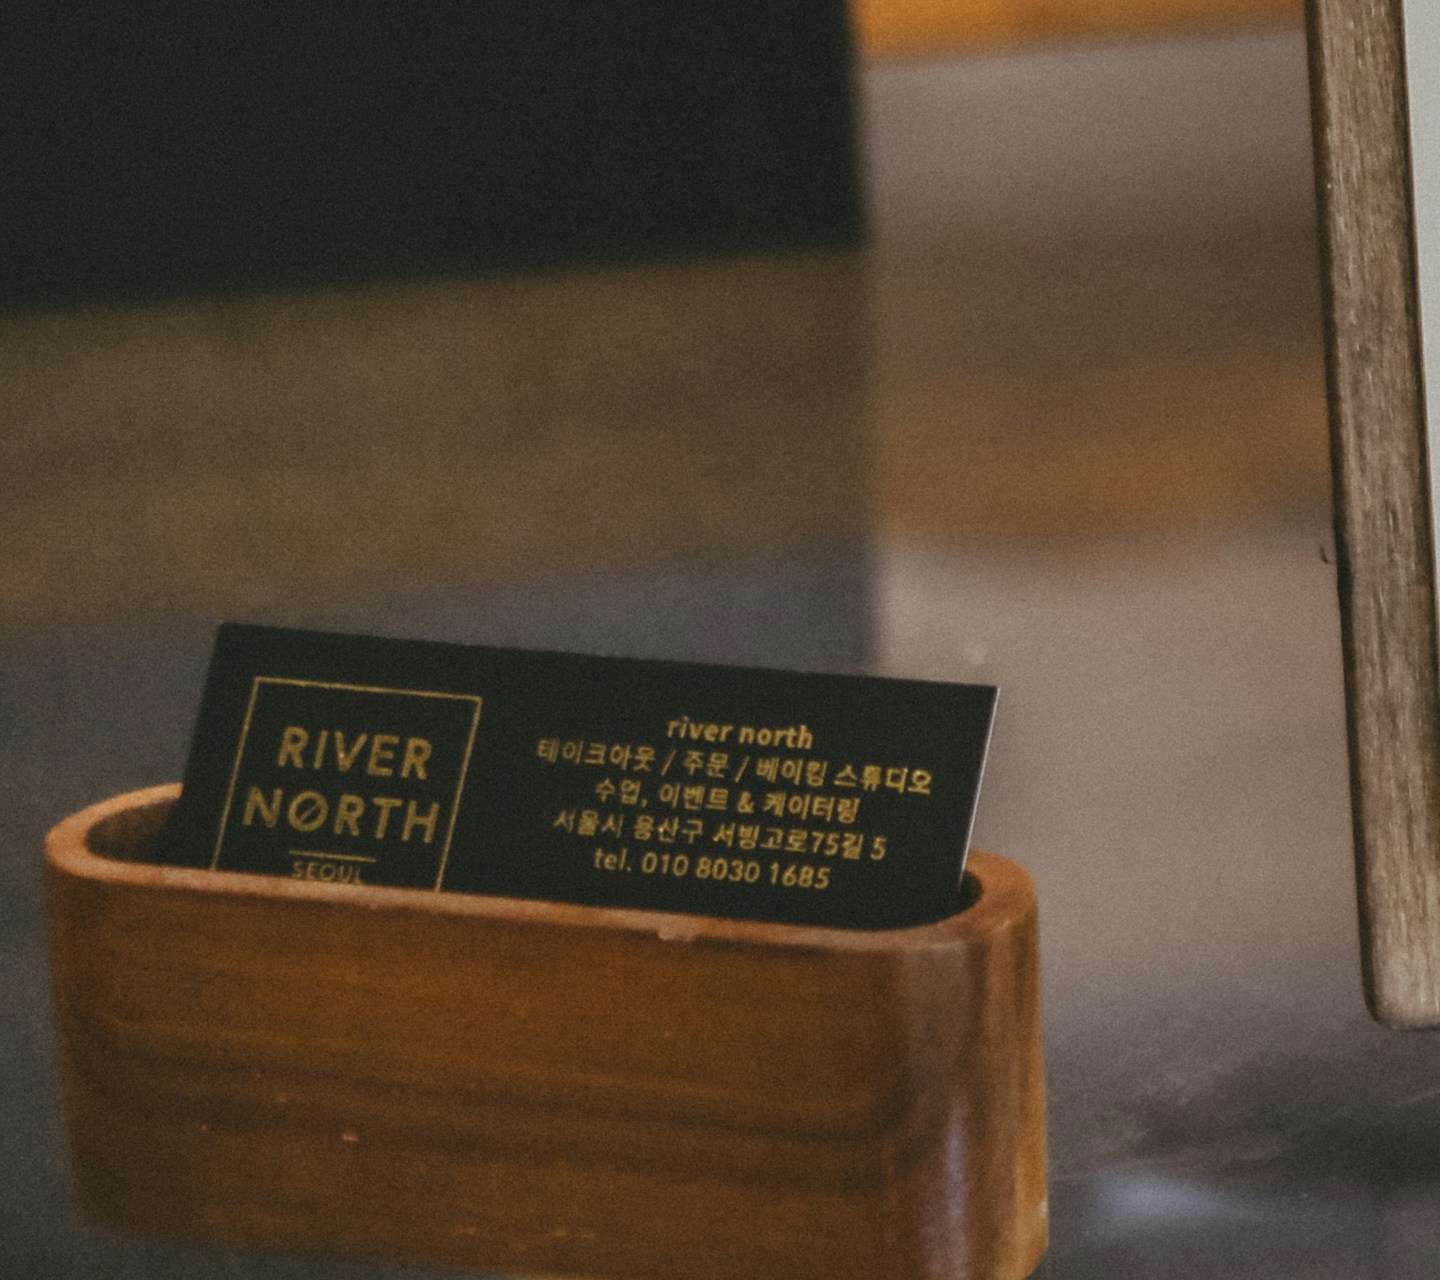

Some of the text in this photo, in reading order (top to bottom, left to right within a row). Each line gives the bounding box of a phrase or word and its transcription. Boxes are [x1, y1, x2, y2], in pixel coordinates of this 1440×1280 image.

[277, 726, 433, 780] RIVER
[666, 715, 814, 750] river north
[536, 738, 656, 772] 테이크아웃
[682, 749, 729, 778] 주문
[755, 756, 829, 788] 베이킹
[833, 763, 933, 796] 스튜디오
[595, 776, 861, 824] 수업, 이벤트 & 케이터링
[552, 807, 887, 861] 서울시 용산구 서빙고로75길 5
[594, 846, 831, 890] tel. 010 8030 1685
